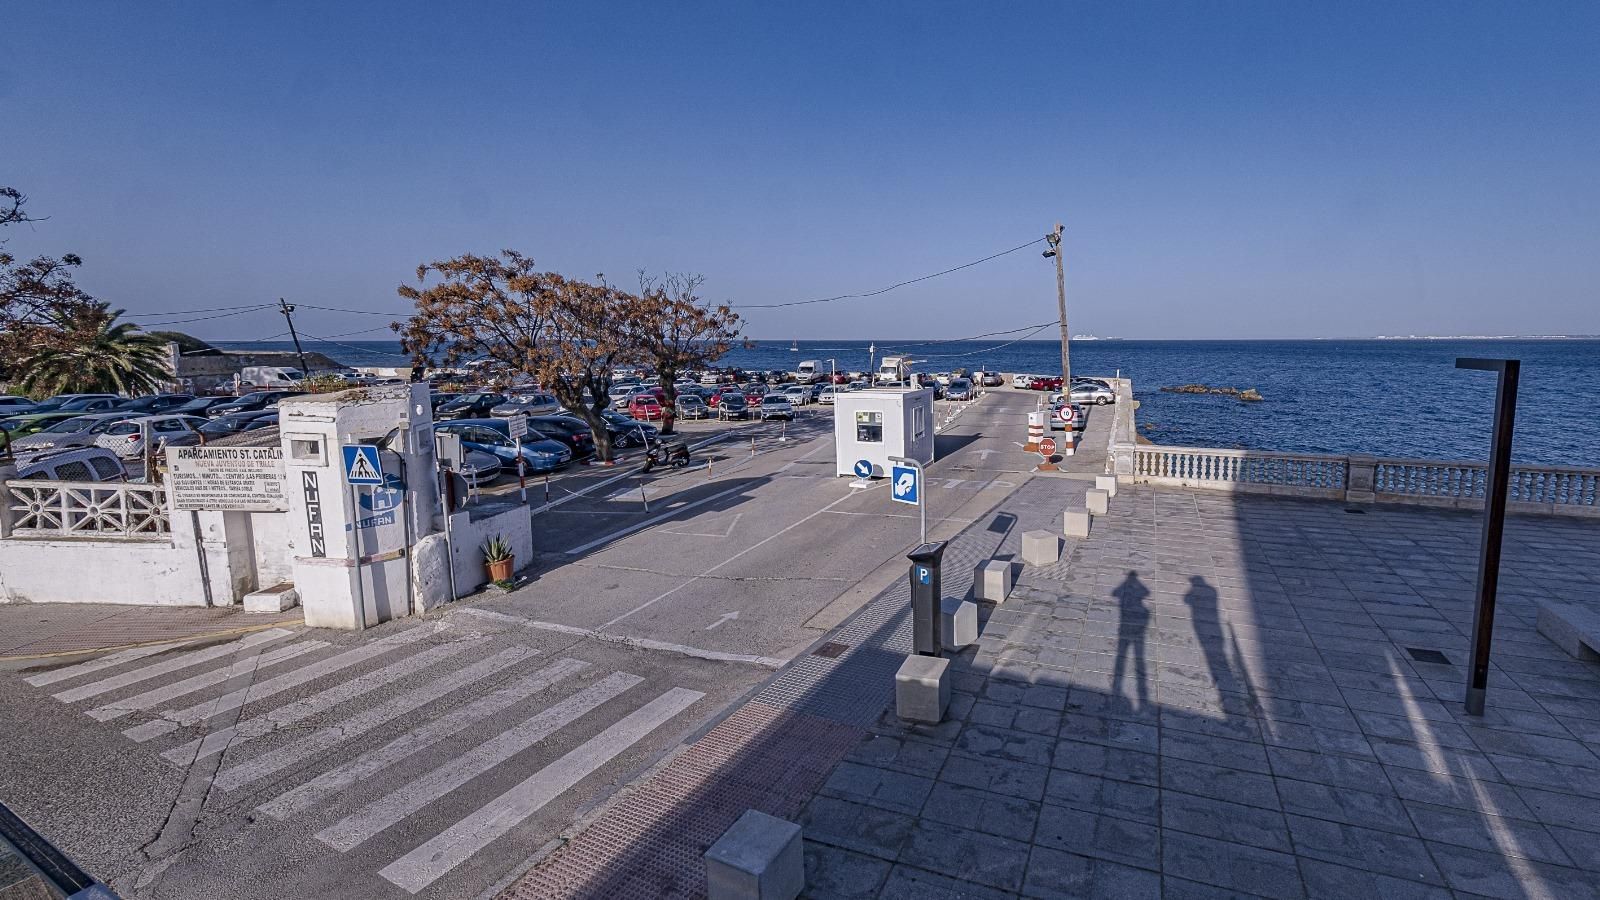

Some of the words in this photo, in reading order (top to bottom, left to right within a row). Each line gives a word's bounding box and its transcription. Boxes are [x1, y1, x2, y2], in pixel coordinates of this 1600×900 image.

[178, 450, 238, 459] APARCAMIENTO
[240, 450, 252, 460] ST.
[304, 474, 324, 554] NUFAN
[356, 516, 392, 529] NUFAN
[920, 568, 928, 581] P
